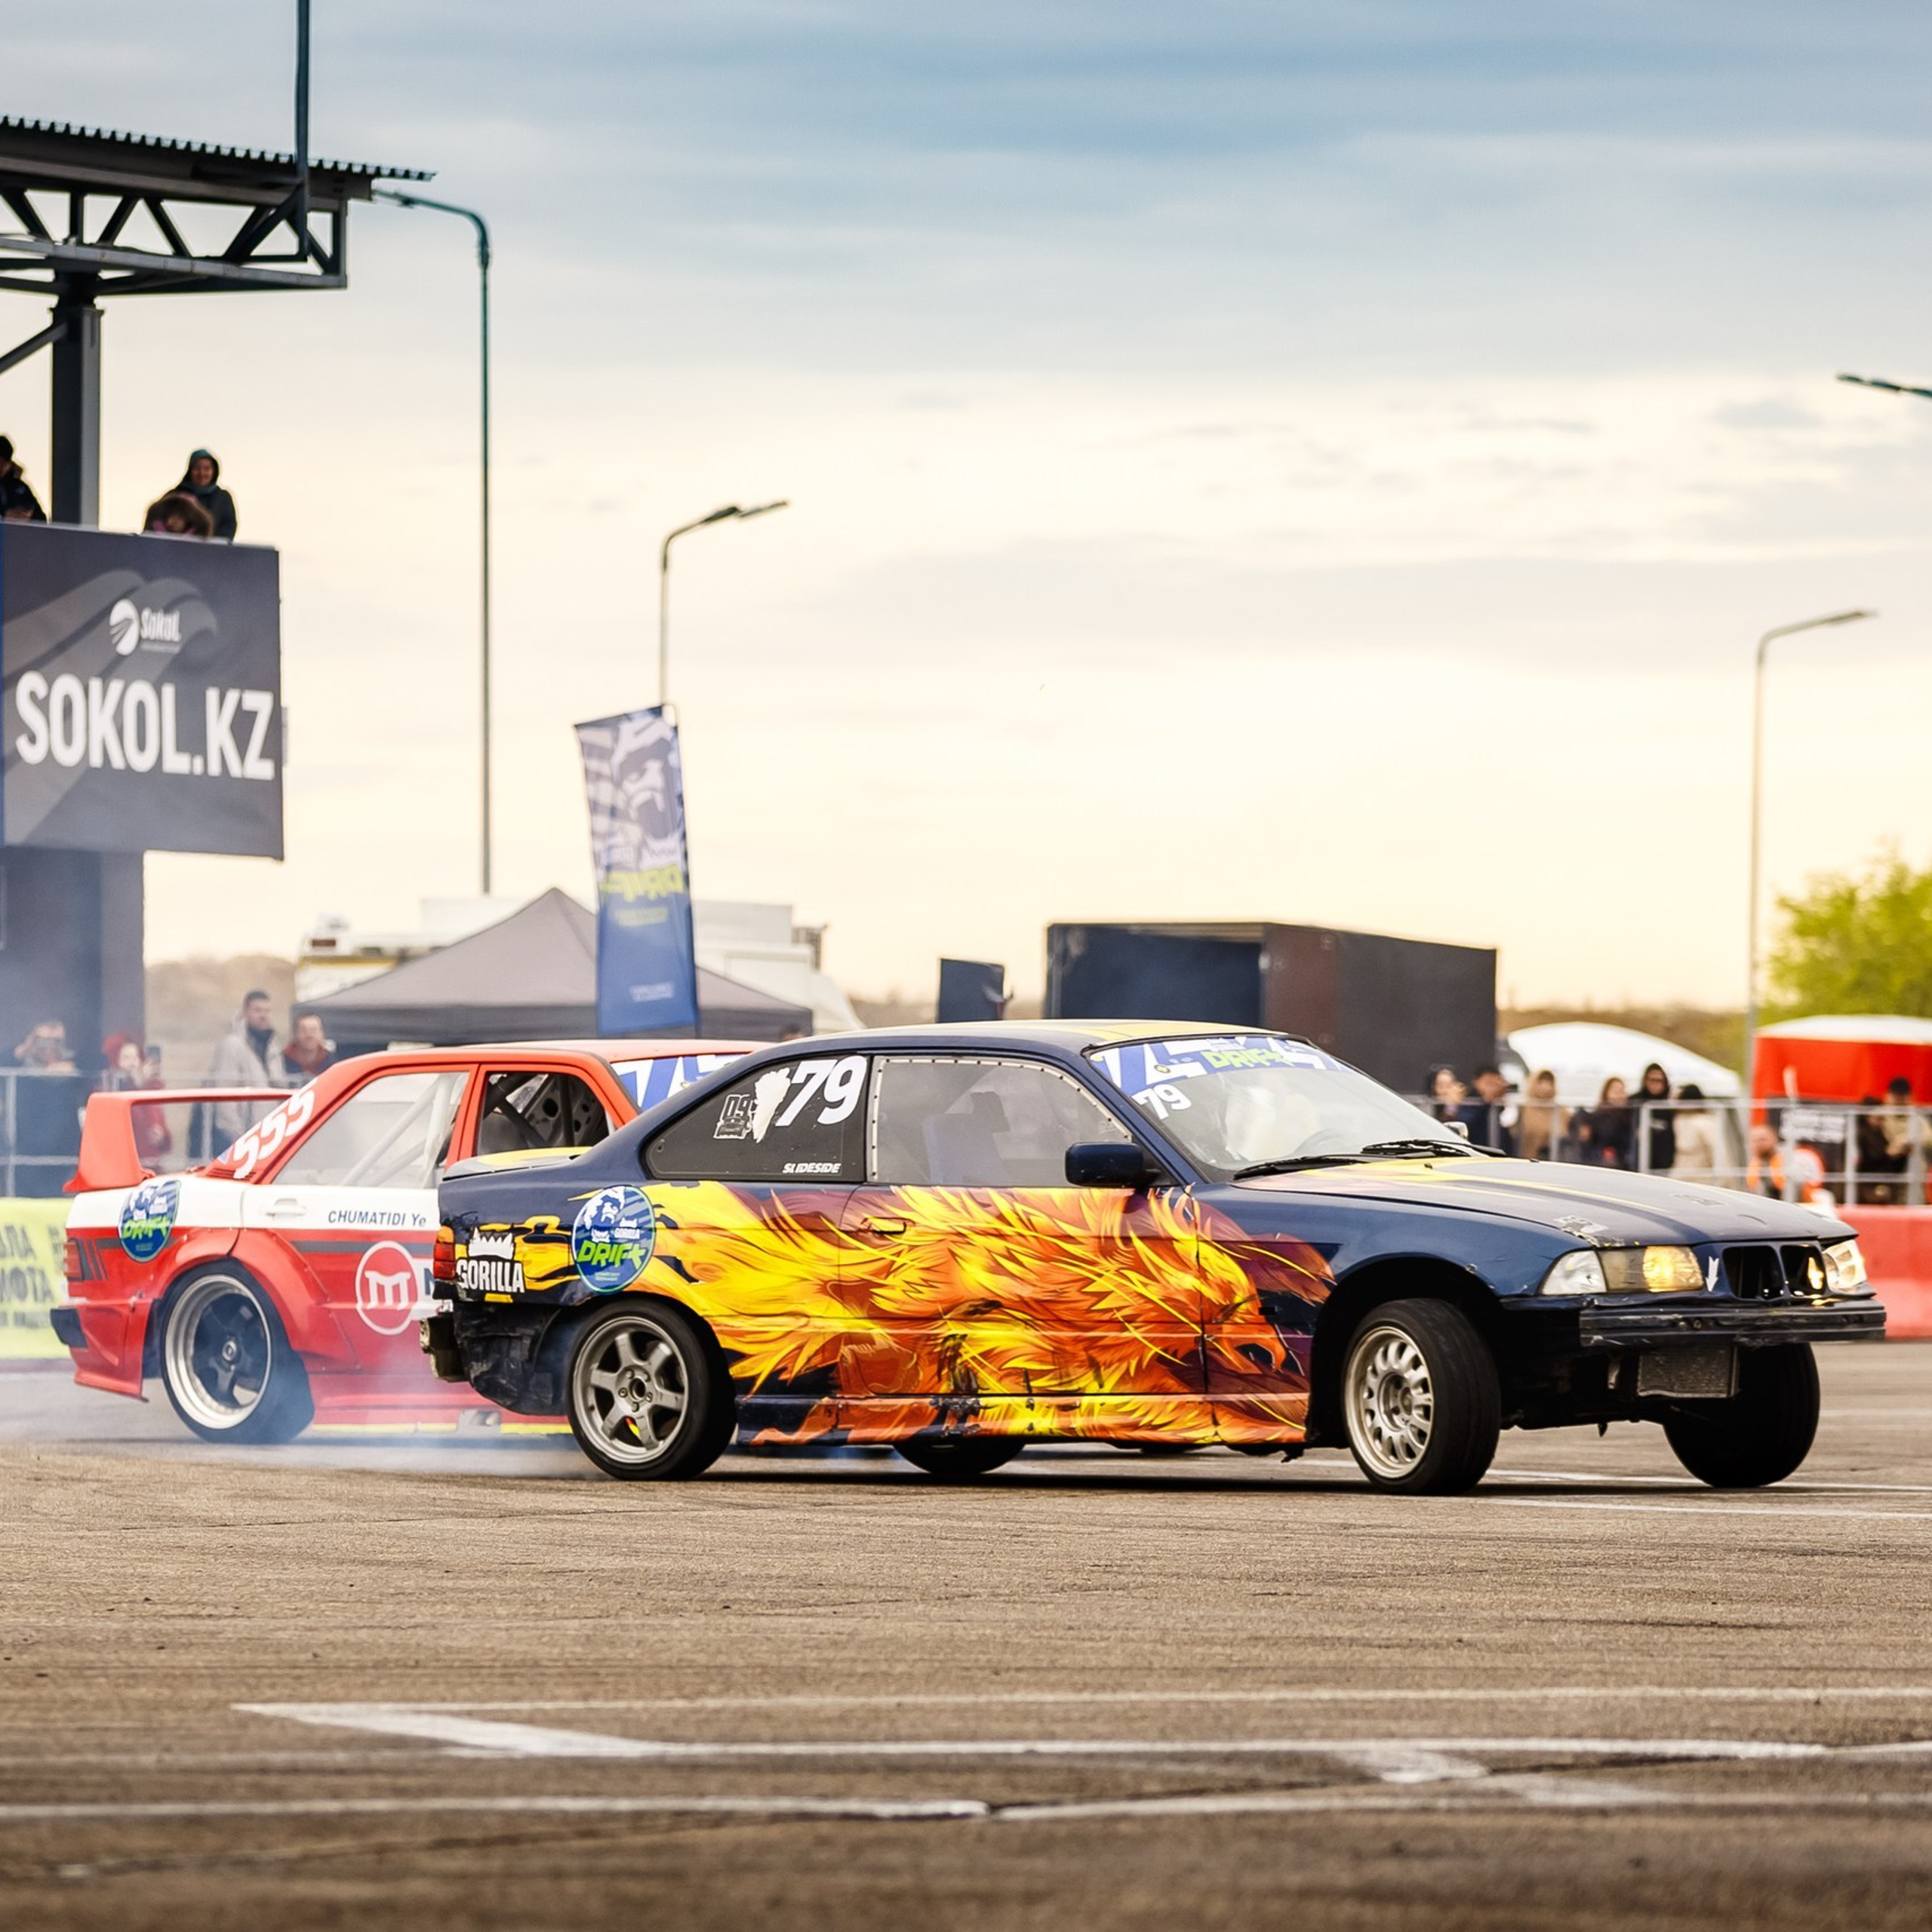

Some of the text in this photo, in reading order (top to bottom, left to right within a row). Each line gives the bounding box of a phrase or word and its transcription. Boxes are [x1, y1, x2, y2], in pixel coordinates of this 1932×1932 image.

[15, 670, 275, 780] SOKOL.KZ
[775, 1055, 867, 1126] 79
[1131, 1084, 1192, 1120] 79
[232, 1077, 318, 1179] 555
[782, 1162, 841, 1174] SLIDESIDE
[328, 1210, 426, 1227] CHUMATIDI Ye
[577, 1240, 646, 1269] DRIFT
[456, 1259, 525, 1293] GORILLA
